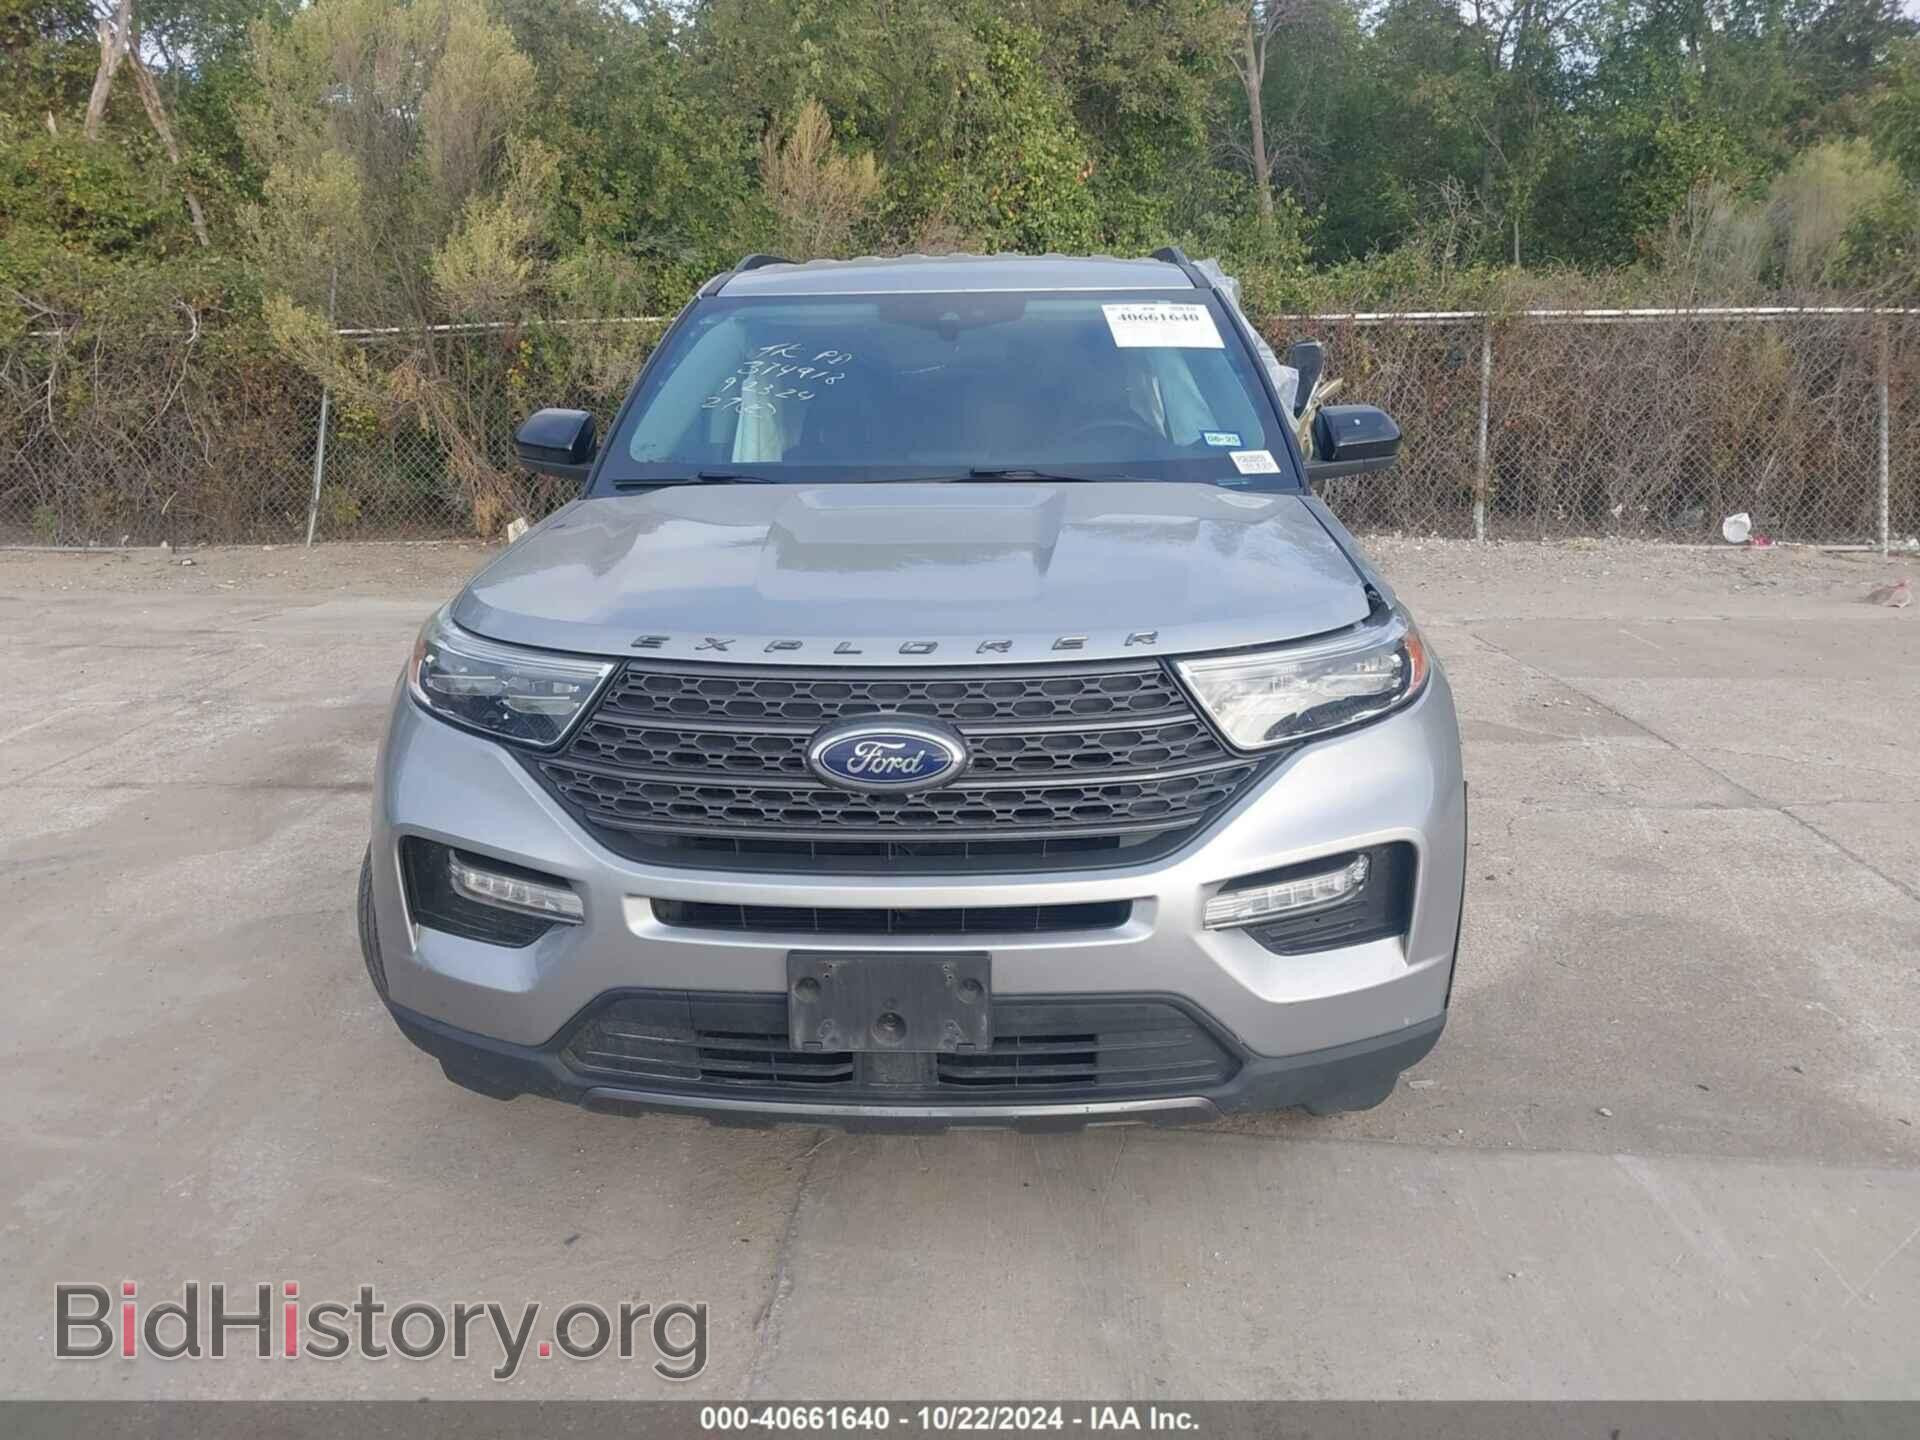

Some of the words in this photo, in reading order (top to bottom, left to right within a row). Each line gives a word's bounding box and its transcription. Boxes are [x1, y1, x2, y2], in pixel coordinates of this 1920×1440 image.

[1117, 312, 1200, 322] 40661640
[630, 630, 1159, 655] EXPLORER
[847, 741, 926, 774] Ford
